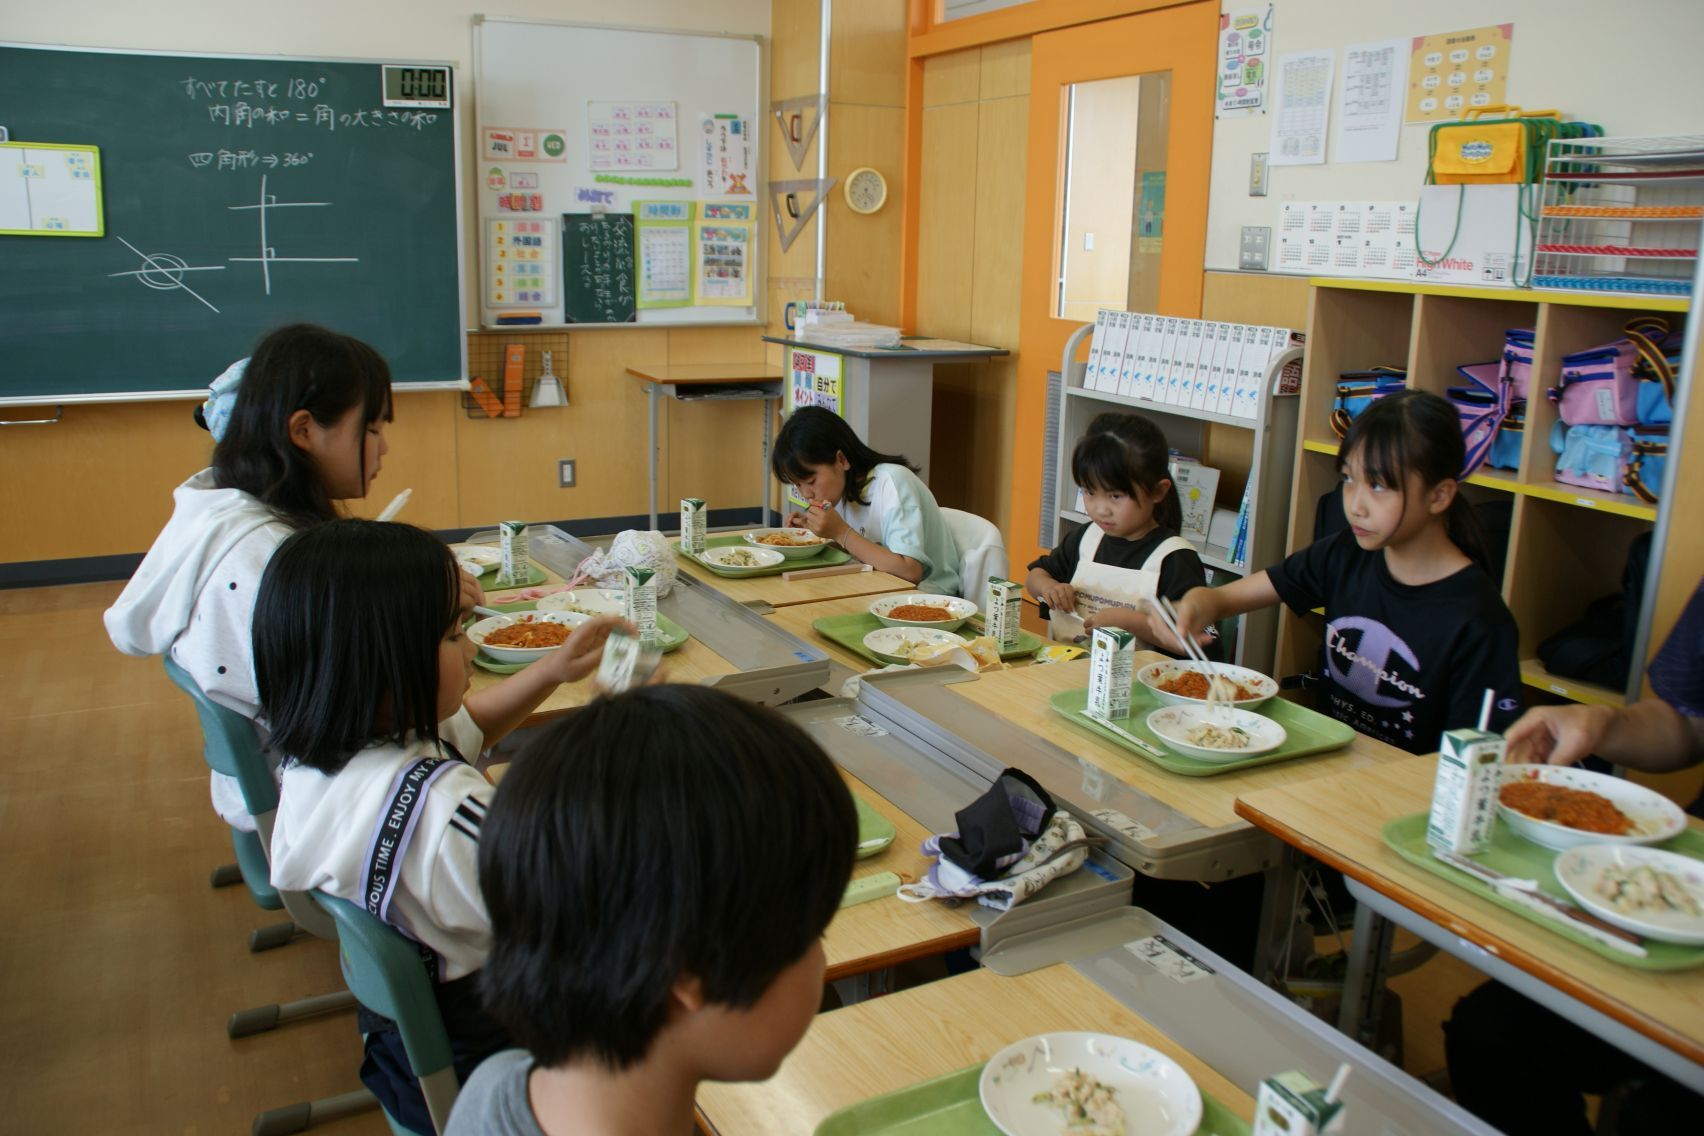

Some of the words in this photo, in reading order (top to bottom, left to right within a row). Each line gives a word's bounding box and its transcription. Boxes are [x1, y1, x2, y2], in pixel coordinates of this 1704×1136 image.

[180, 76, 280, 100] すべてたすと
[208, 101, 290, 128] 内角の和
[188, 149, 260, 171] 四角形
[1442, 256, 1474, 271] White
[1326, 623, 1427, 699] Champion
[388, 783, 416, 830] ENJOY
[409, 764, 430, 782] MY
